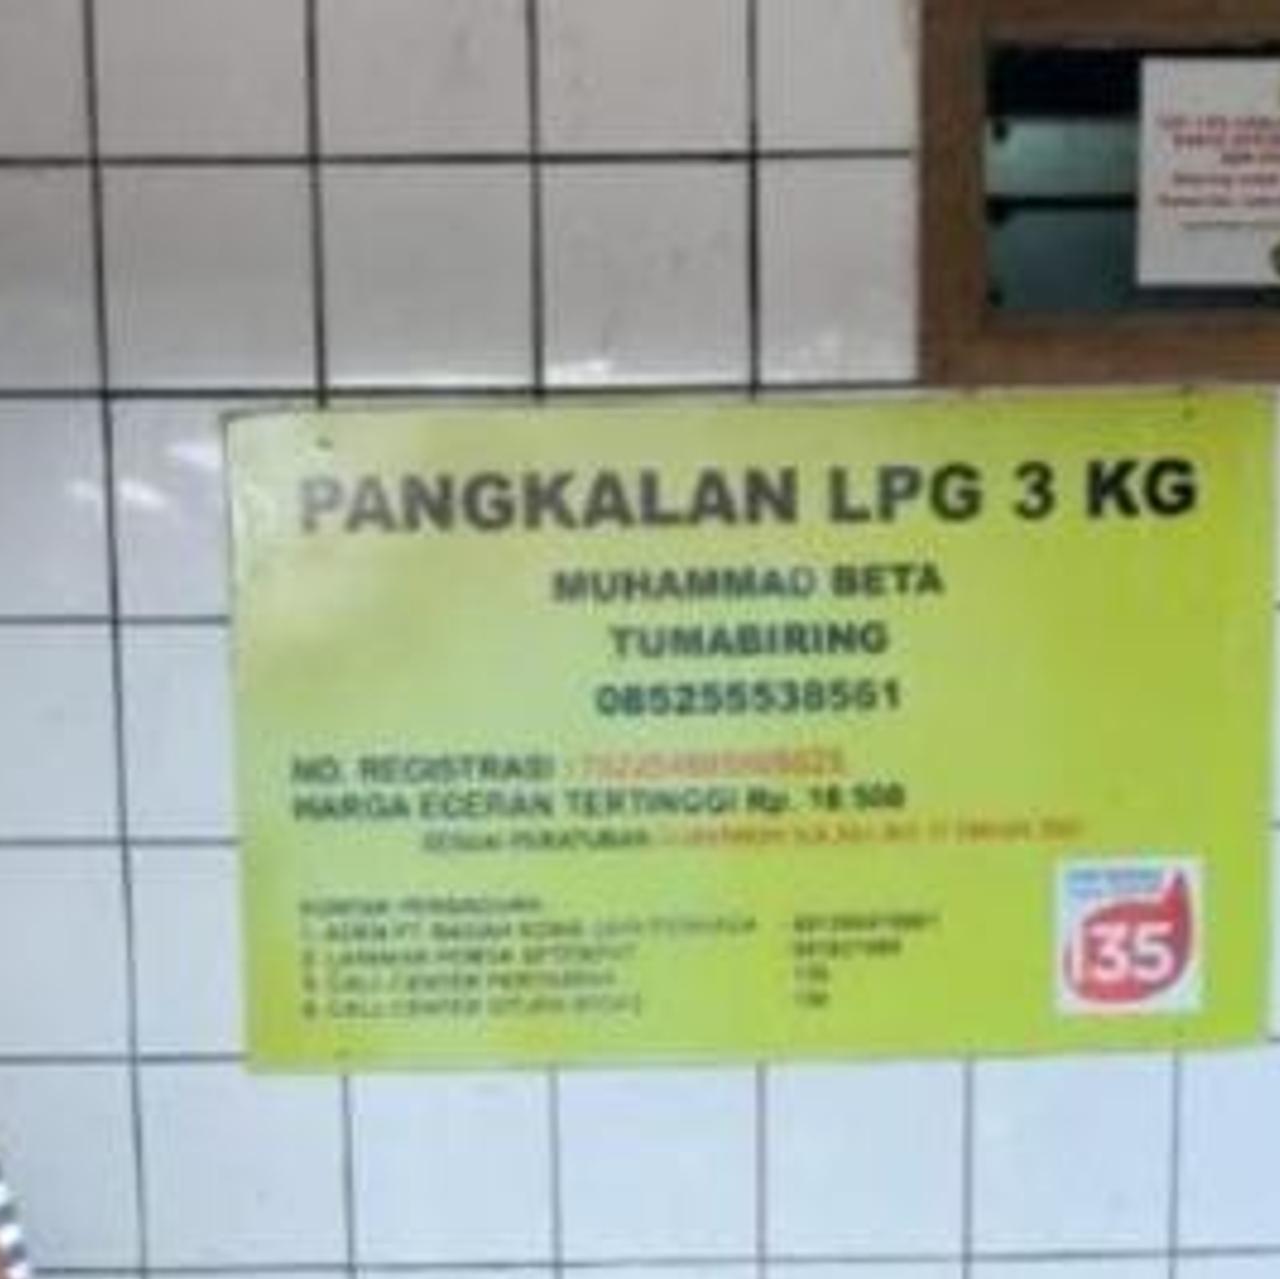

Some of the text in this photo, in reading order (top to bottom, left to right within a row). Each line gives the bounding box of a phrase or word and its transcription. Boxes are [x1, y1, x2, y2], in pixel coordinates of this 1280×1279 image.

[300, 457, 1199, 533] PANGKALAN LPG 3 KG
[552, 562, 945, 602] MUHAMMAD BETA
[609, 621, 889, 658] TUMABIRING
[359, 751, 556, 783] REGISTRASI
[293, 789, 411, 821] HARGA
[419, 787, 555, 818] ECERAN
[562, 784, 737, 817] TERTINGGI
